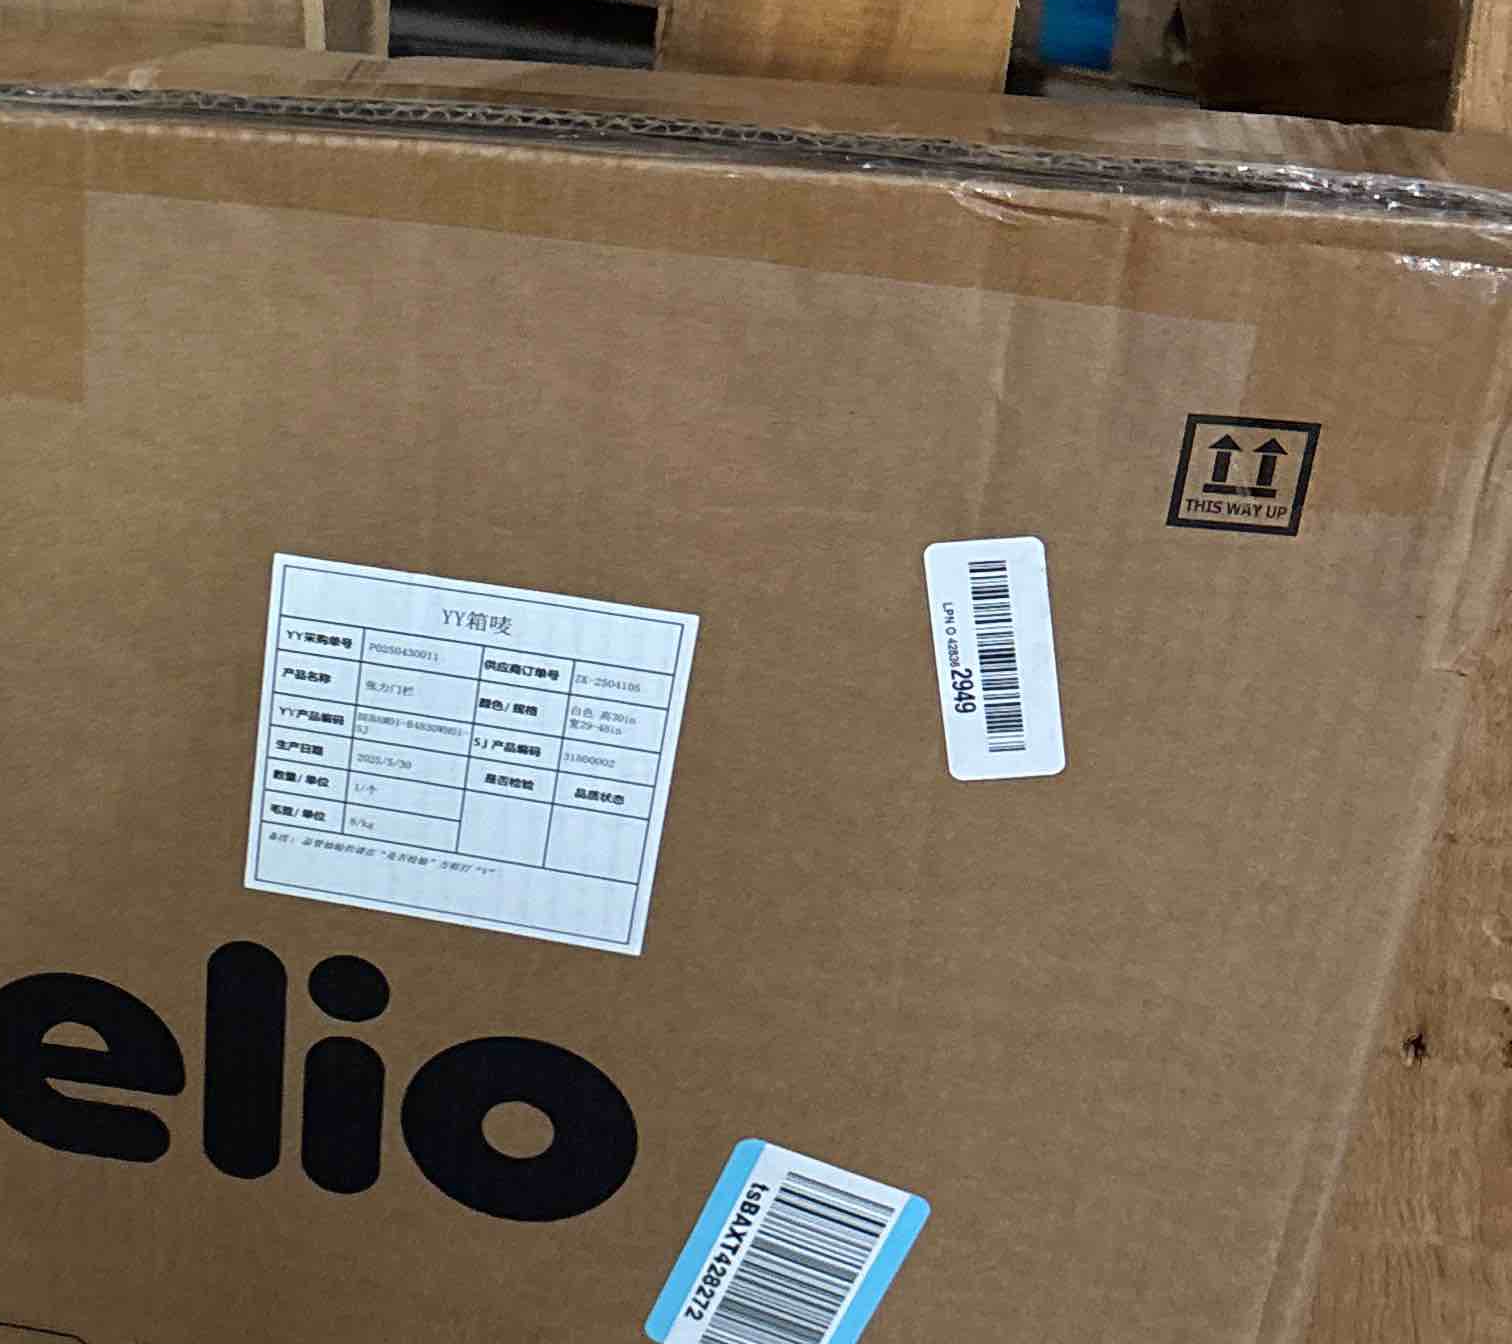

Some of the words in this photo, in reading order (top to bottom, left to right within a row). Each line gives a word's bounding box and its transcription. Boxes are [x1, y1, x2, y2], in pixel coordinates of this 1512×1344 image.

[1185, 498, 1223, 515] THIS
[1226, 501, 1263, 517] WAY
[1265, 504, 1288, 520] UP
[943, 602, 955, 624] LPN
[950, 668, 977, 714] 2949
[281, 667, 332, 685] 产品名称
[275, 739, 324, 757] 生产日期
[573, 787, 625, 806] 品质状态
[683, 1181, 770, 1322] tsBAXT428272
